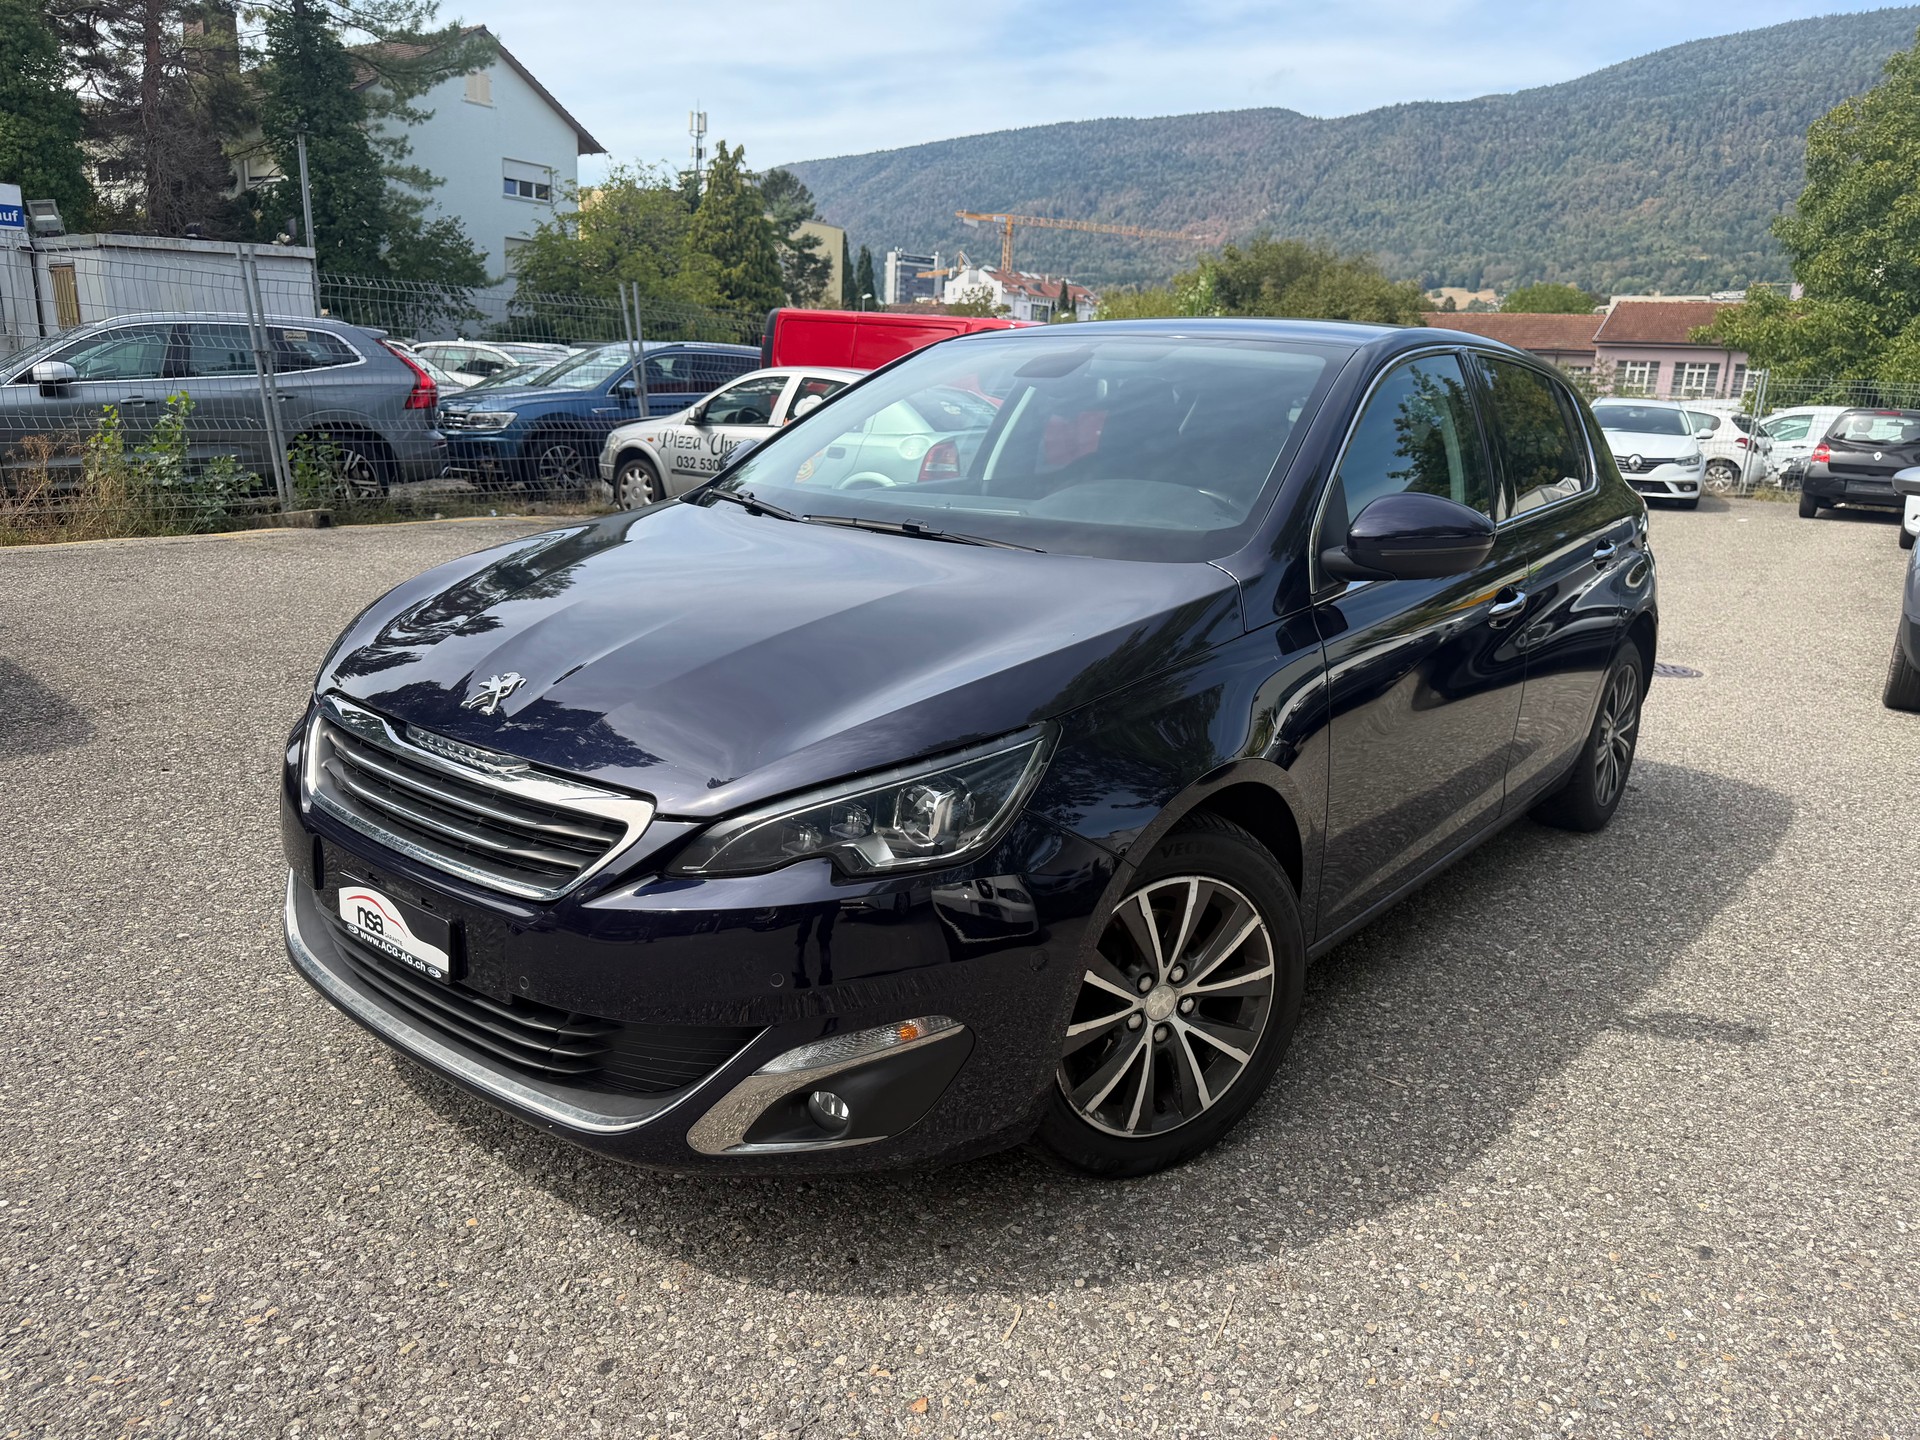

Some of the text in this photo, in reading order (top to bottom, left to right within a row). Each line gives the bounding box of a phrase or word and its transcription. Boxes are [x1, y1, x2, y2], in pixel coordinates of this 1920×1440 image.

[0, 210, 18, 222] uf
[658, 429, 701, 454] Pizza
[676, 455, 720, 472] 032 530
[418, 732, 489, 762] PEUGEOT
[357, 905, 384, 936] nsa
[359, 930, 426, 972] www.ACG-AG.ch
